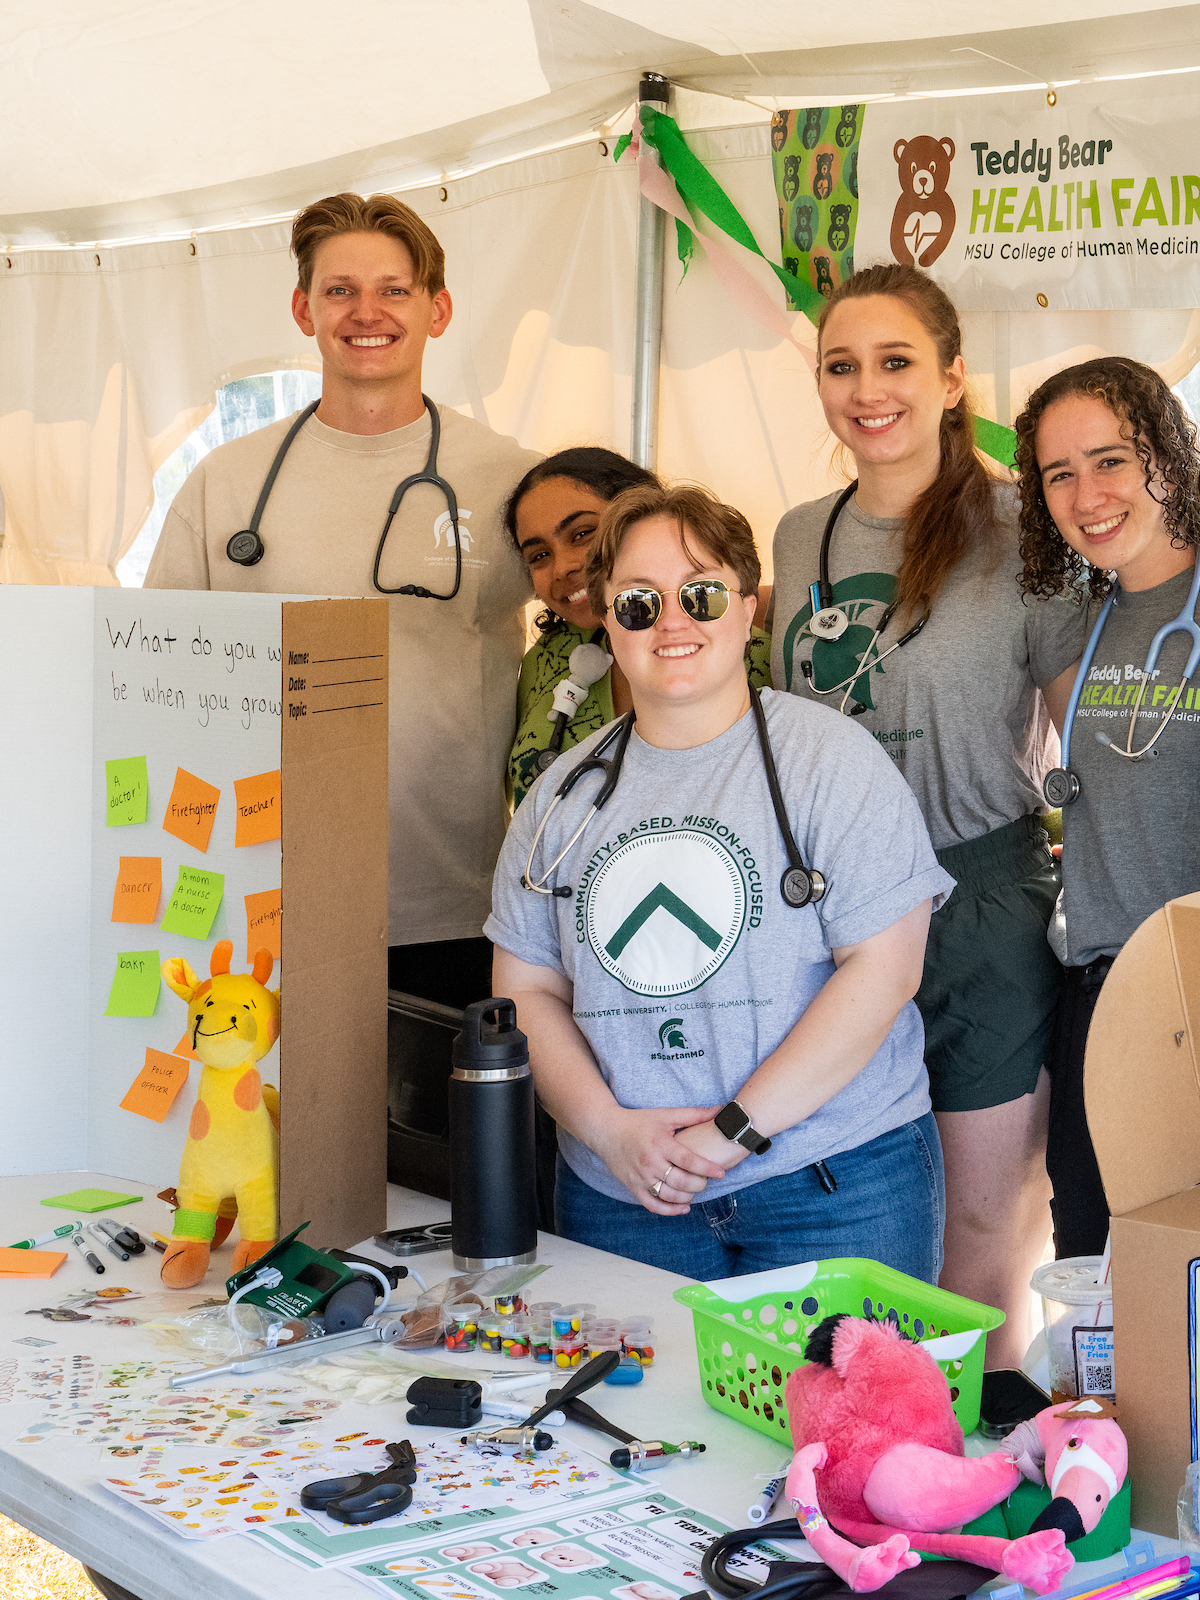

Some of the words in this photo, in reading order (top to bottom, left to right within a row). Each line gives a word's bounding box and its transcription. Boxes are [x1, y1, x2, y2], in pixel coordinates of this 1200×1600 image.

[970, 138, 1052, 183] Teddy
[1058, 133, 1113, 171] Bear
[969, 180, 1100, 235] HEALTH
[964, 243, 994, 260] MSU
[1000, 242, 1056, 262] College
[1061, 240, 1073, 258] of
[1077, 240, 1134, 260] Human
[106, 617, 177, 653] What
[191, 625, 212, 655] do
[224, 642, 257, 673] you
[288, 651, 309, 666] Name:
[1088, 664, 1121, 685] Teddy
[288, 677, 306, 692] Date:
[111, 671, 128, 700] be
[143, 677, 185, 709] when
[198, 693, 230, 727] you
[241, 695, 282, 730] grow
[1079, 685, 1149, 706] HEALTH
[288, 703, 307, 721] Topic:
[1092, 709, 1118, 718] College
[1120, 709, 1128, 717] of
[114, 776, 120, 787] A
[110, 782, 141, 808] doctor!
[171, 802, 216, 825] Firefighter
[239, 797, 275, 818] Teacher
[182, 872, 188, 881] A
[189, 875, 210, 885] mom
[576, 816, 677, 944] COMMUNITY-BASED.
[682, 814, 763, 932] MISSION-FOCUSED.
[121, 882, 153, 893] Dancer
[178, 886, 184, 894] A
[186, 888, 211, 900] nurse
[173, 900, 178, 909] A
[180, 901, 207, 916] doctor
[597, 1008, 621, 1018] STATE
[674, 1001, 706, 1011] COLLEGE
[718, 999, 746, 1008] HUMAN
[651, 1050, 704, 1061] #SpartanMD
[1080, 1343, 1096, 1351] Any
[1087, 1351, 1108, 1359] Fries
[674, 1520, 713, 1536] TEDDY
[608, 1533, 632, 1546] BLOOD
